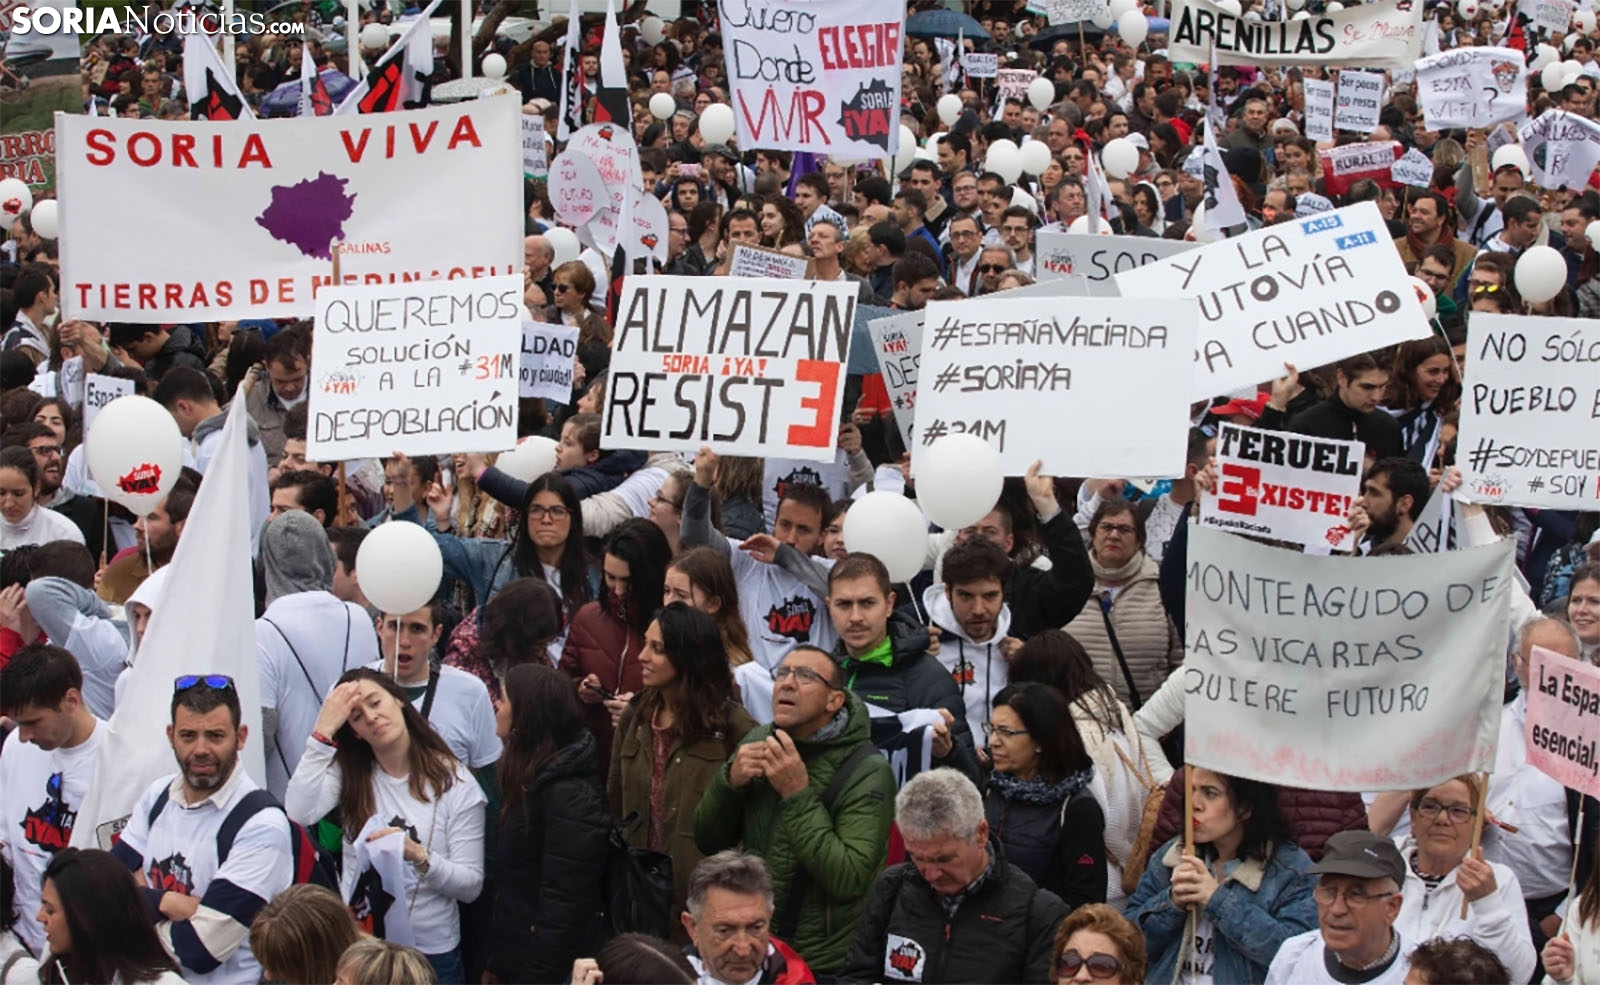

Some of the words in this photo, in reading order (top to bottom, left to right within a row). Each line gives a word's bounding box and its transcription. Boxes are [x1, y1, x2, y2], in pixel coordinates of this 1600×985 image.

[1174, 6, 1336, 54] ARENILLAS
[733, 39, 816, 84] Donde
[737, 84, 831, 145] VIVIR
[86, 127, 273, 169] SORIA
[340, 114, 482, 163] VIVA
[1335, 155, 1376, 171] RURAL
[1171, 254, 1202, 290] Y
[1237, 234, 1291, 269] LA
[75, 280, 233, 309] TIERRAS
[250, 278, 295, 305] DE
[1197, 253, 1354, 321] UTOVÍA
[325, 290, 518, 333] QUEREMOS
[616, 282, 855, 363] ALMAZÁN
[1252, 290, 1401, 350] CUANDO
[345, 334, 470, 366] SOLUCIÓN
[662, 354, 710, 374] SORIA
[721, 358, 767, 377] ¡YA!
[1480, 331, 1526, 362] NO
[379, 371, 394, 390] A
[414, 366, 441, 387] LA
[458, 353, 513, 381] #31M
[933, 358, 1071, 393] #SORIAYA
[315, 390, 513, 442] DESPOBLACIÓN
[1473, 383, 1576, 415] PUEBLO
[1220, 426, 1358, 476] TERUEL
[1446, 576, 1499, 612] DE
[1251, 634, 1423, 668] VICARIAS
[1185, 669, 1297, 715] QUIERE
[1327, 683, 1429, 718] FUTURO
[1538, 664, 1557, 697] La
[1562, 673, 1600, 718] Espa
[1532, 723, 1600, 777] esencial,
